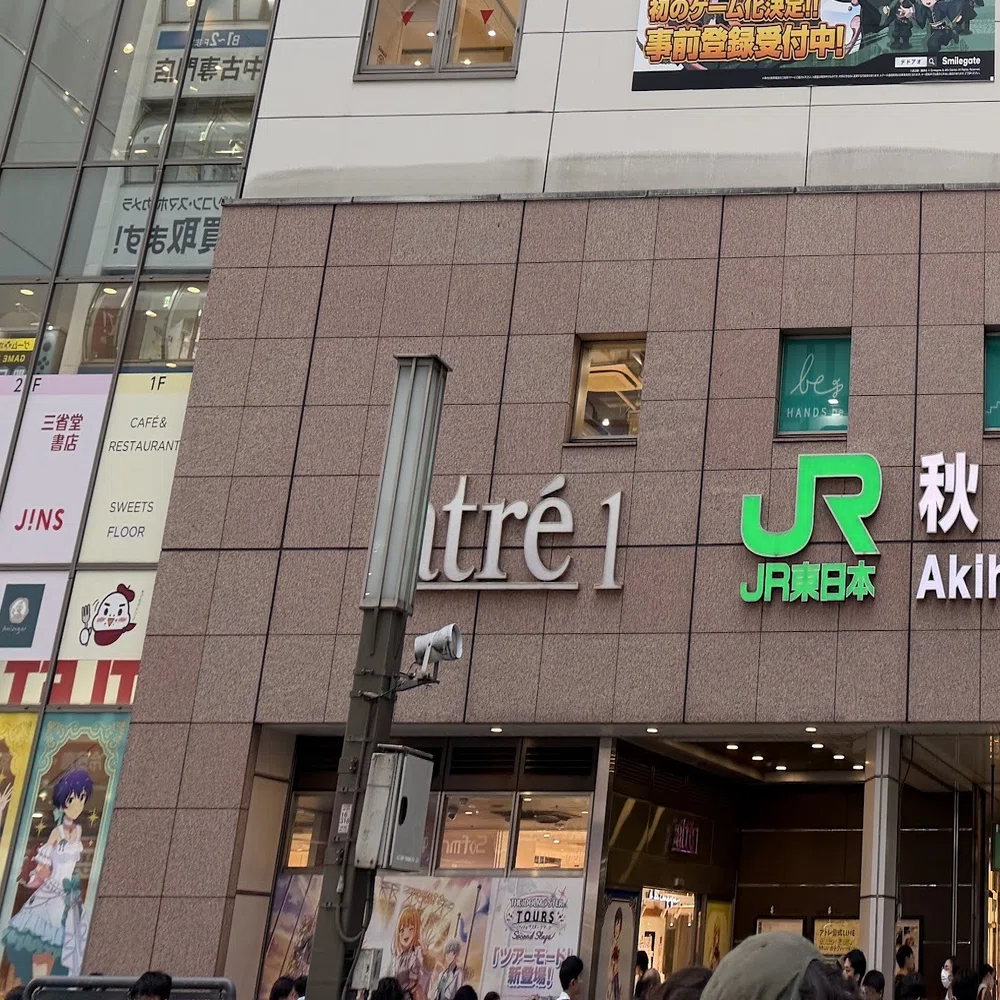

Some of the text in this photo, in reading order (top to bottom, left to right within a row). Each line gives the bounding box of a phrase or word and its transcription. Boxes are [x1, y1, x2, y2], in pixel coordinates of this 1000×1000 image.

[645, 24, 845, 62] 事前登録受付中!
[942, 56, 981, 66] Smilegate
[150, 376, 167, 391] 1F
[786, 407, 828, 418] HANDS
[41, 413, 84, 432] 三省堂
[51, 434, 80, 452] 書店
[108, 440, 181, 452] RESTAURANT
[109, 501, 154, 513] SWEETS
[740, 453, 883, 558] JR
[107, 526, 146, 538] FLOOR
[740, 561, 877, 602] JR東日本
[516, 911, 555, 923] TOURS
